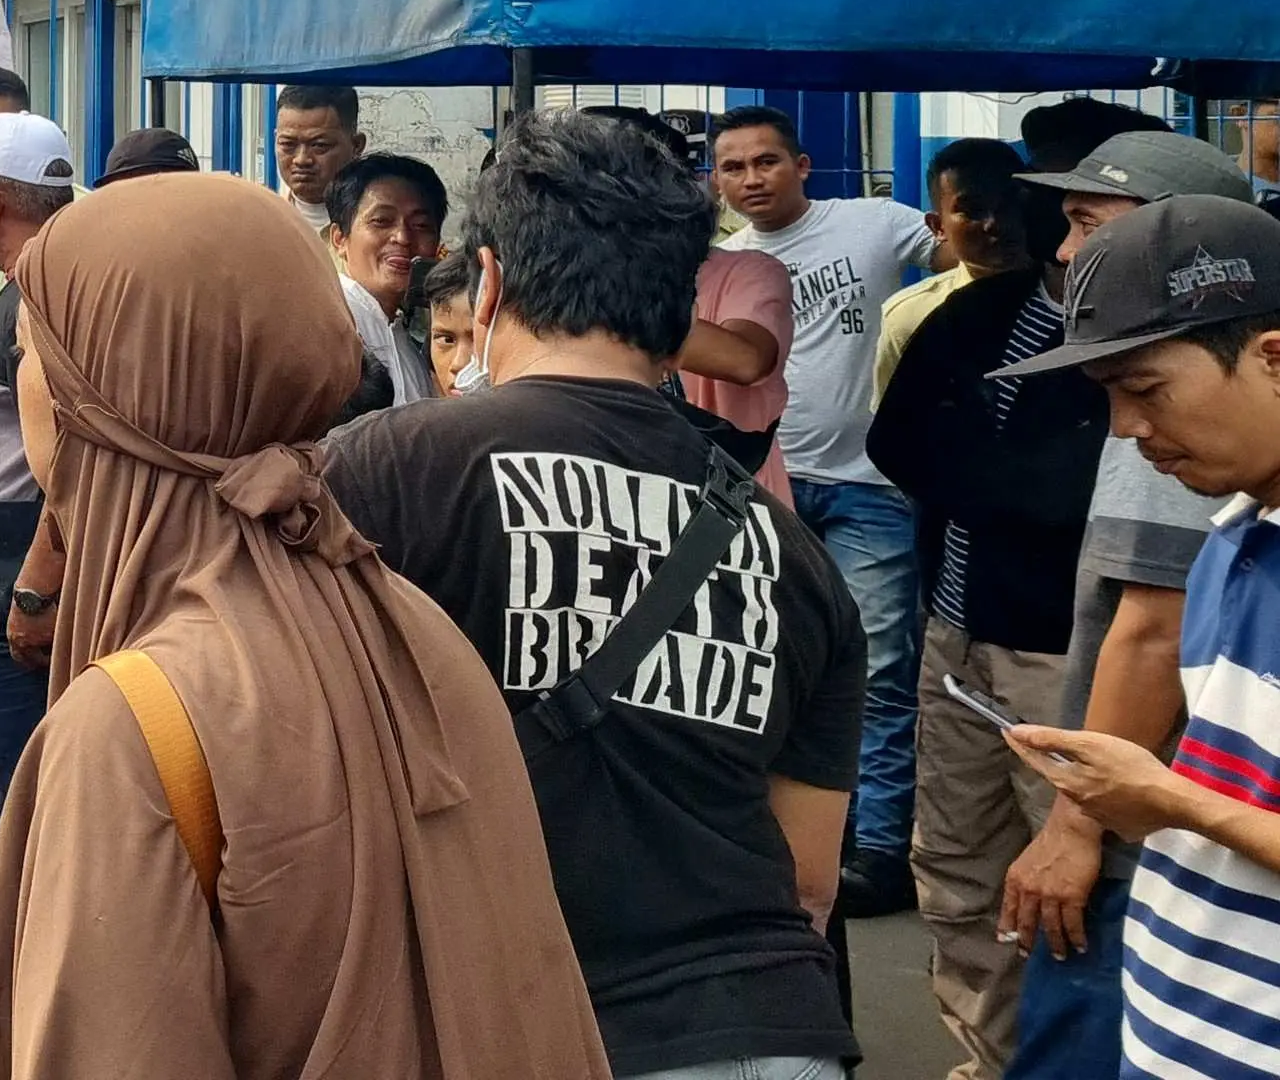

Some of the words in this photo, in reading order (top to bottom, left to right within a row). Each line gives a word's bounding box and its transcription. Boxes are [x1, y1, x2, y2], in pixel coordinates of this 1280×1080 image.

[1166, 258, 1257, 297] SUPERSTAR
[828, 285, 867, 311] WEAR
[840, 308, 865, 335] 96
[505, 608, 775, 733] BRADE
